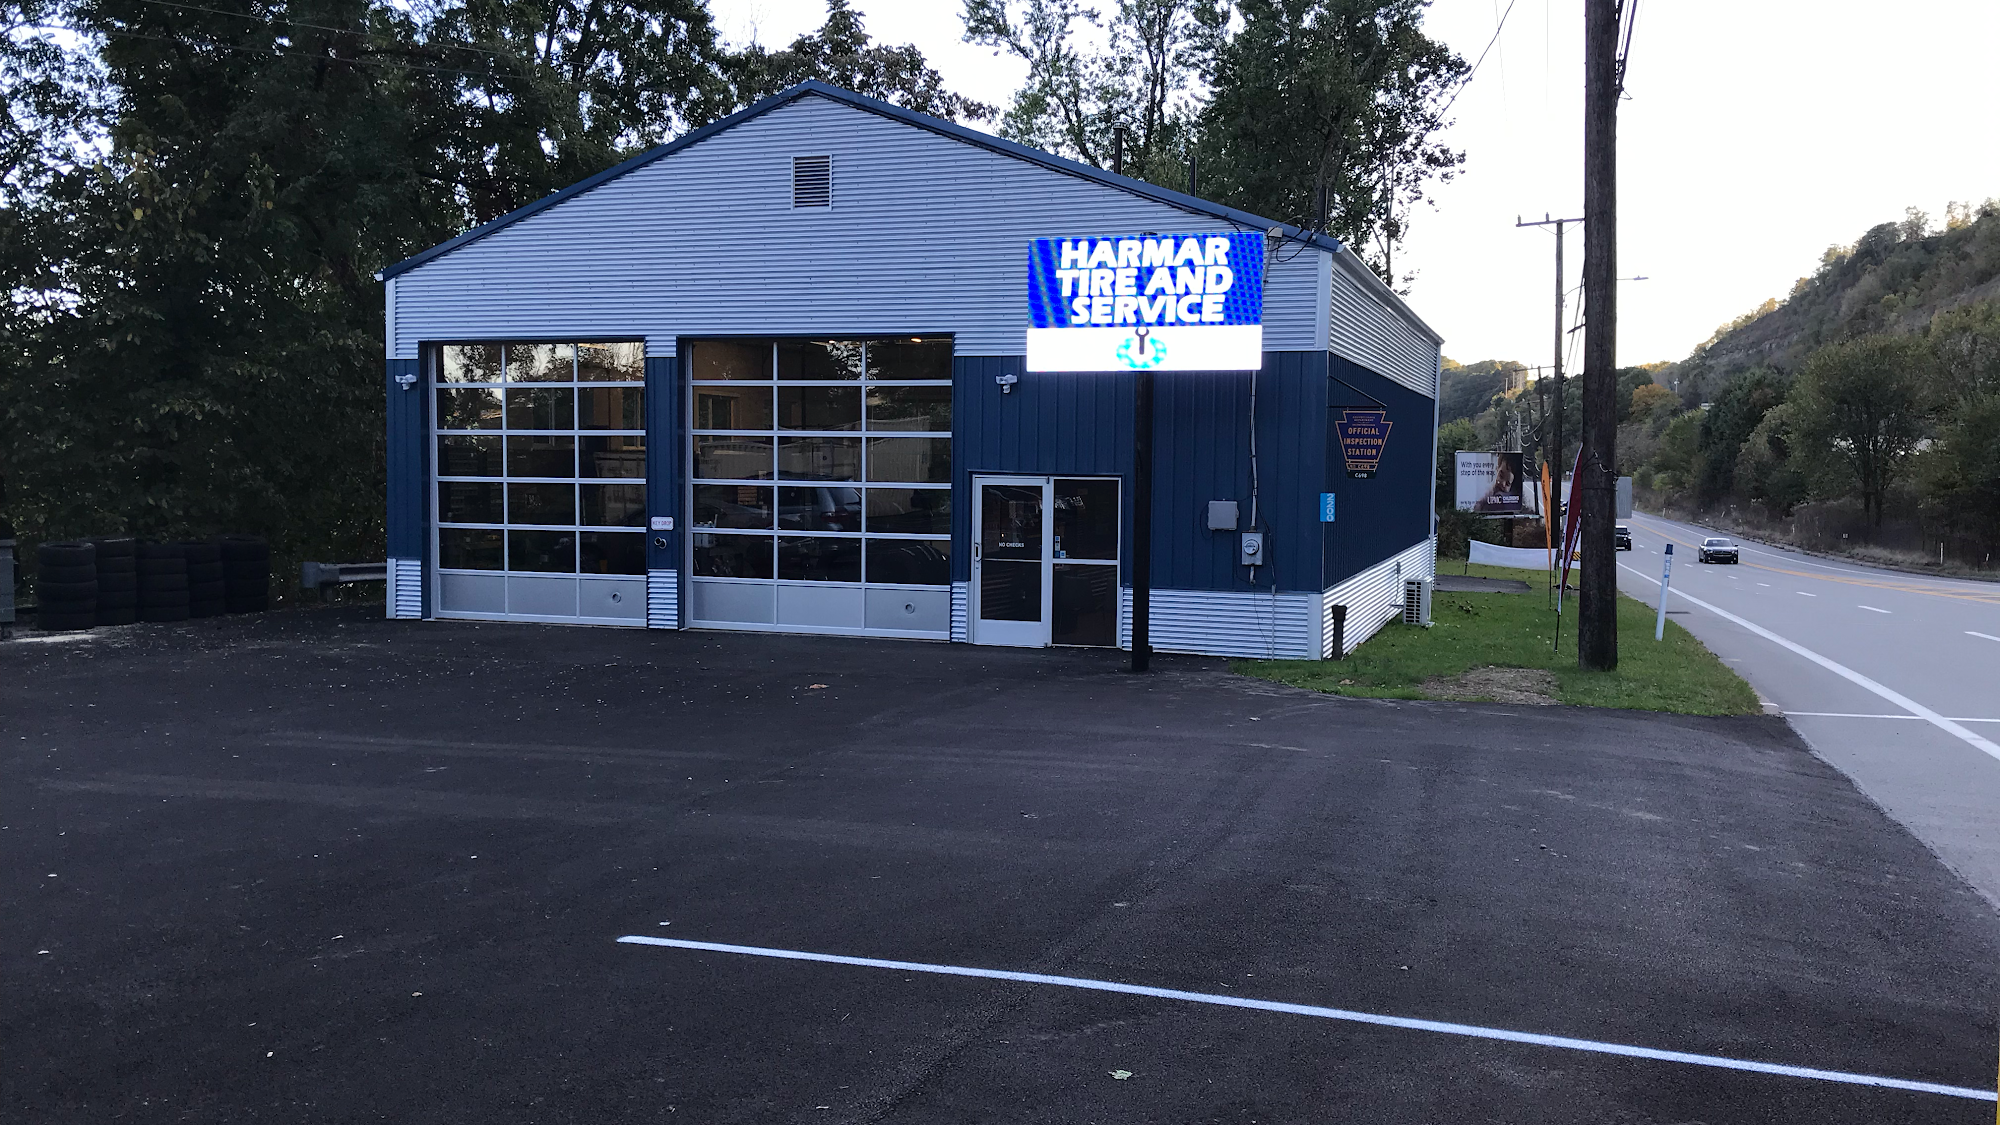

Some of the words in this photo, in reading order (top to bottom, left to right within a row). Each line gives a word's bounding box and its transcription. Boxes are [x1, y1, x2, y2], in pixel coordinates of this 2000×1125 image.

[1061, 237, 1231, 268] HARMAR
[1056, 268, 1138, 297] TIRE
[1144, 265, 1234, 295] AND
[1071, 294, 1226, 324] SERVICE
[1348, 427, 1380, 435] OFFICIAL
